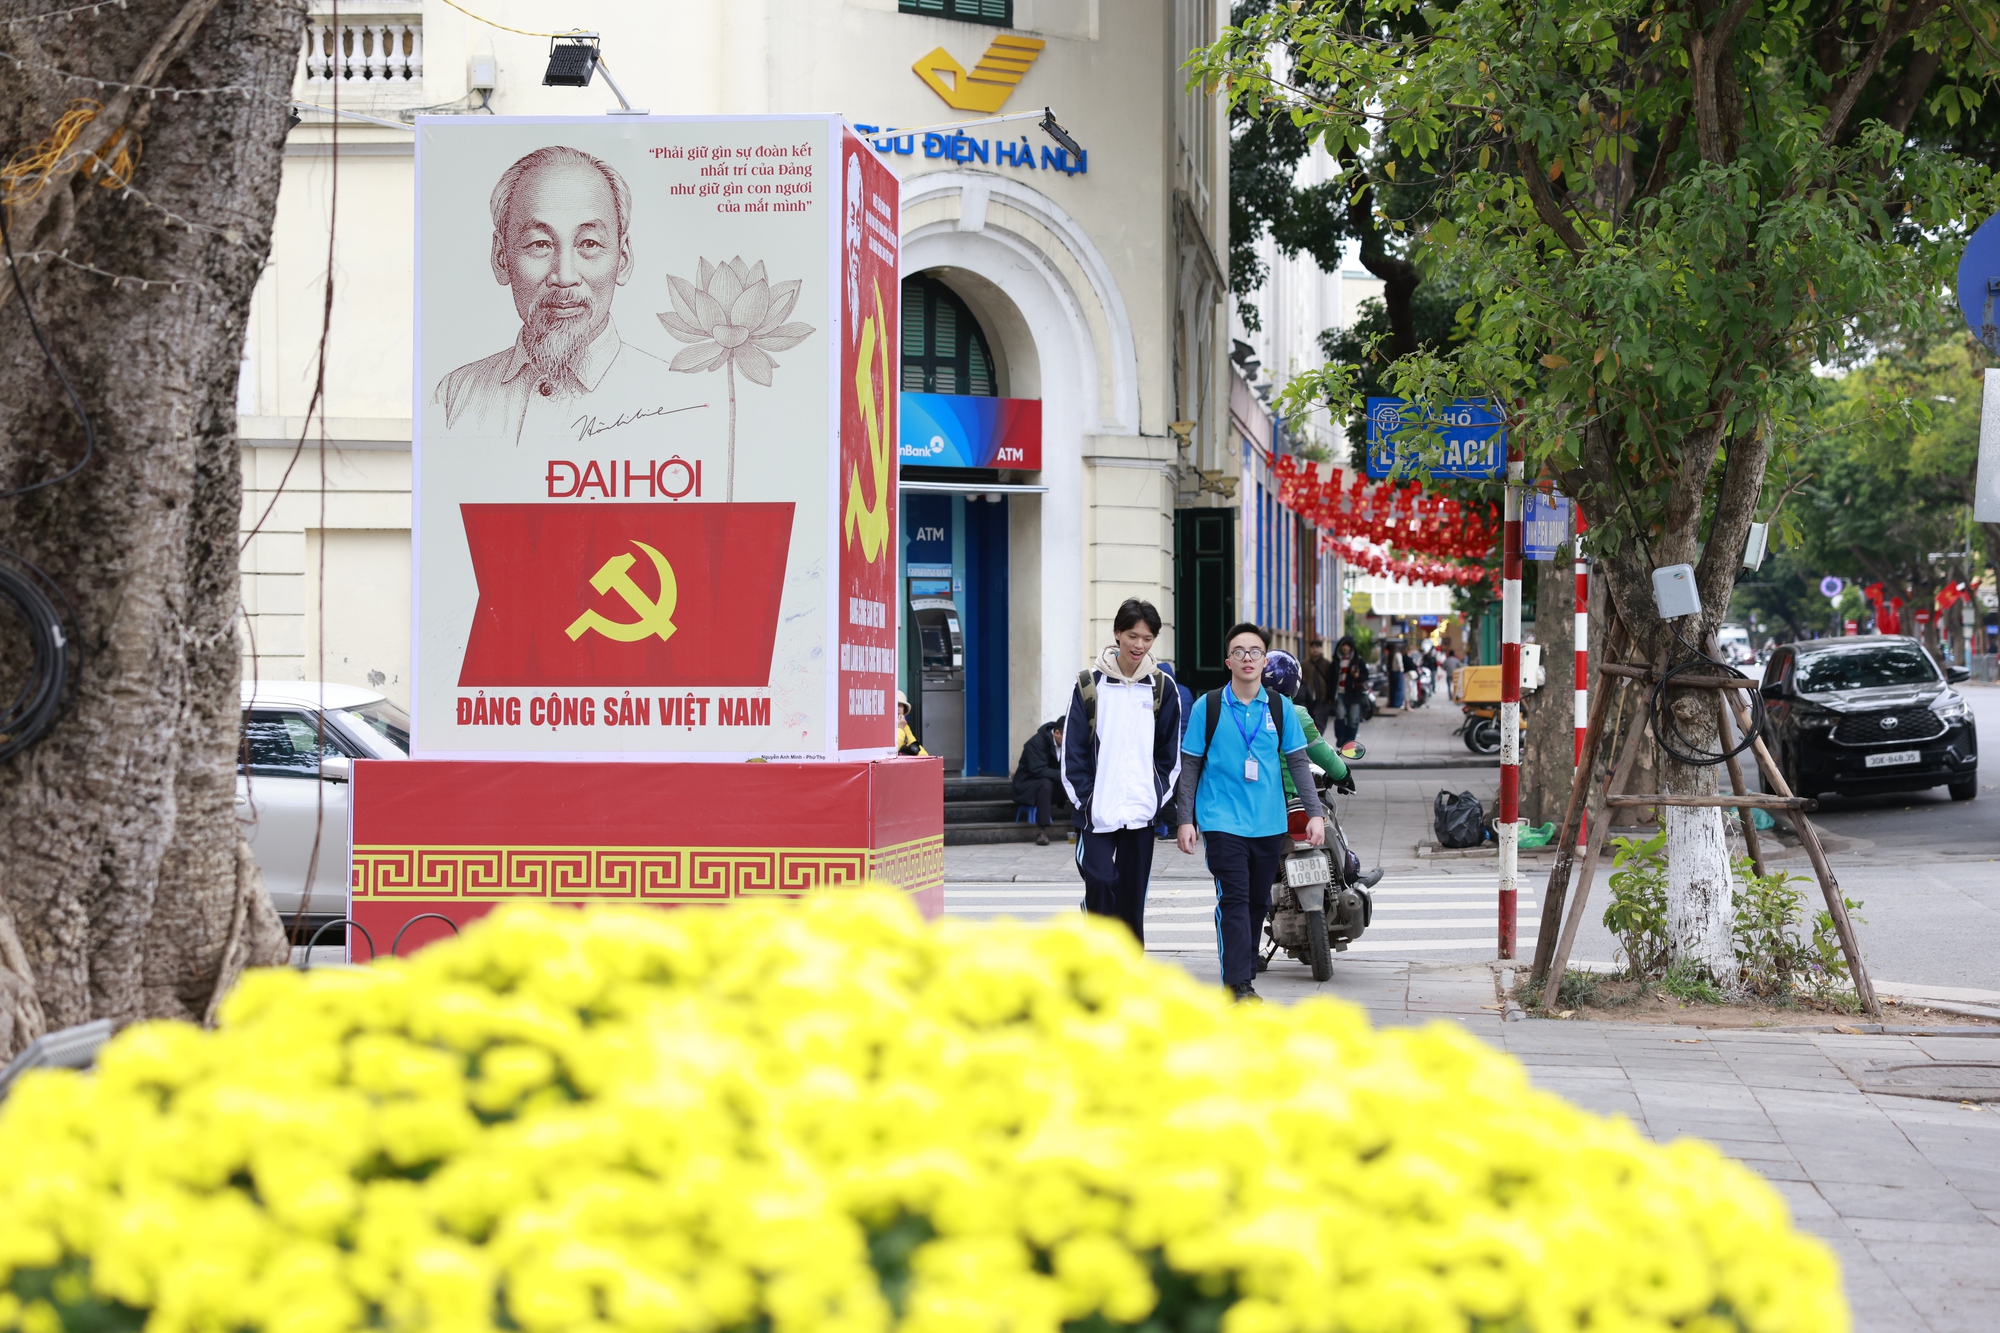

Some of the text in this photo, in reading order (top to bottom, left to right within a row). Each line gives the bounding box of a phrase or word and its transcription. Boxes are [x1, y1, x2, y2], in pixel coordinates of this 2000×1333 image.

[687, 145, 709, 161] giữ
[711, 145, 732, 161] gìn
[736, 146, 752, 160] sự
[755, 145, 788, 157] đoàn
[792, 142, 812, 157] kết
[922, 129, 989, 165] ĐIỆN
[996, 135, 1037, 169] HÀ
[700, 162, 812, 177] nhất trí của Đảng
[670, 181, 812, 197] như giữ gìn con ngươi
[717, 200, 740, 212] của
[744, 198, 769, 212] mắt
[997, 447, 1023, 461] ATM
[1416, 440, 1494, 470] ẠCH
[545, 455, 701, 501] ĐẠI HỘI
[916, 527, 944, 541] ATM
[456, 690, 771, 731] ĐẢNG CỘNG SẢN VIỆT NAM
[1291, 870, 1328, 885] 109.08
